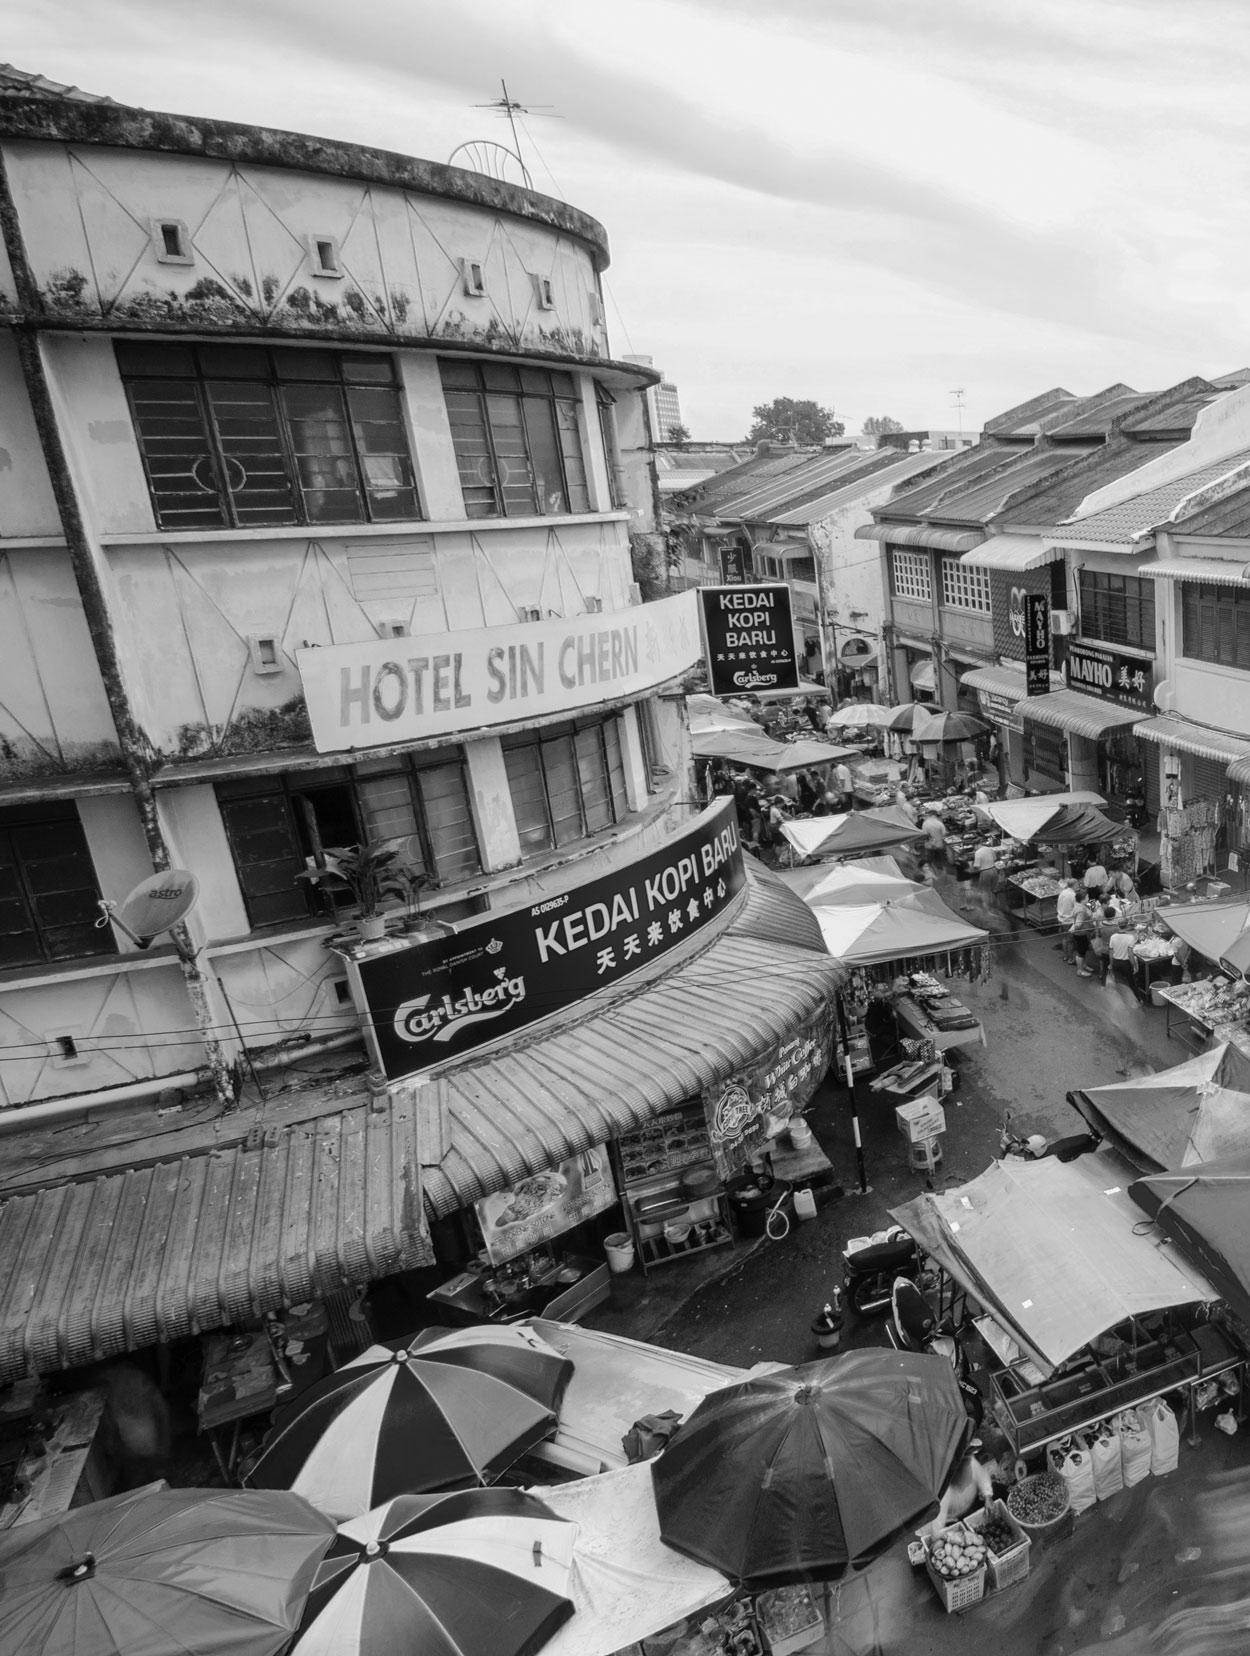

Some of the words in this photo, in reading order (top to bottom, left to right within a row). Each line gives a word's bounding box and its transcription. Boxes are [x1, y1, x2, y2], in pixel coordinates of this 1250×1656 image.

[720, 592, 774, 610] KEDAI
[728, 612, 770, 628] KOPI
[1034, 600, 1046, 648] MAYHO
[726, 630, 776, 647] BARU
[340, 652, 471, 727] HOTEL
[487, 642, 544, 704] SIN
[558, 625, 638, 689] CHERN
[733, 670, 777, 687] Carlsberg
[1028, 668, 1048, 681] 美好
[1070, 656, 1112, 688] MAYHO
[1119, 665, 1146, 693] 美好
[149, 888, 183, 898] astro
[535, 887, 639, 963] KEDAI
[644, 854, 699, 911] KOPI
[701, 821, 737, 877] BARU
[531, 908, 540, 917] AS
[597, 877, 726, 975] 天天来饮食中心
[394, 975, 526, 1042] Carlsberg
[780, 1037, 800, 1058] Penang
[765, 1059, 791, 1088] White
[791, 1039, 816, 1065] Coffee
[735, 1103, 749, 1114] TREE
